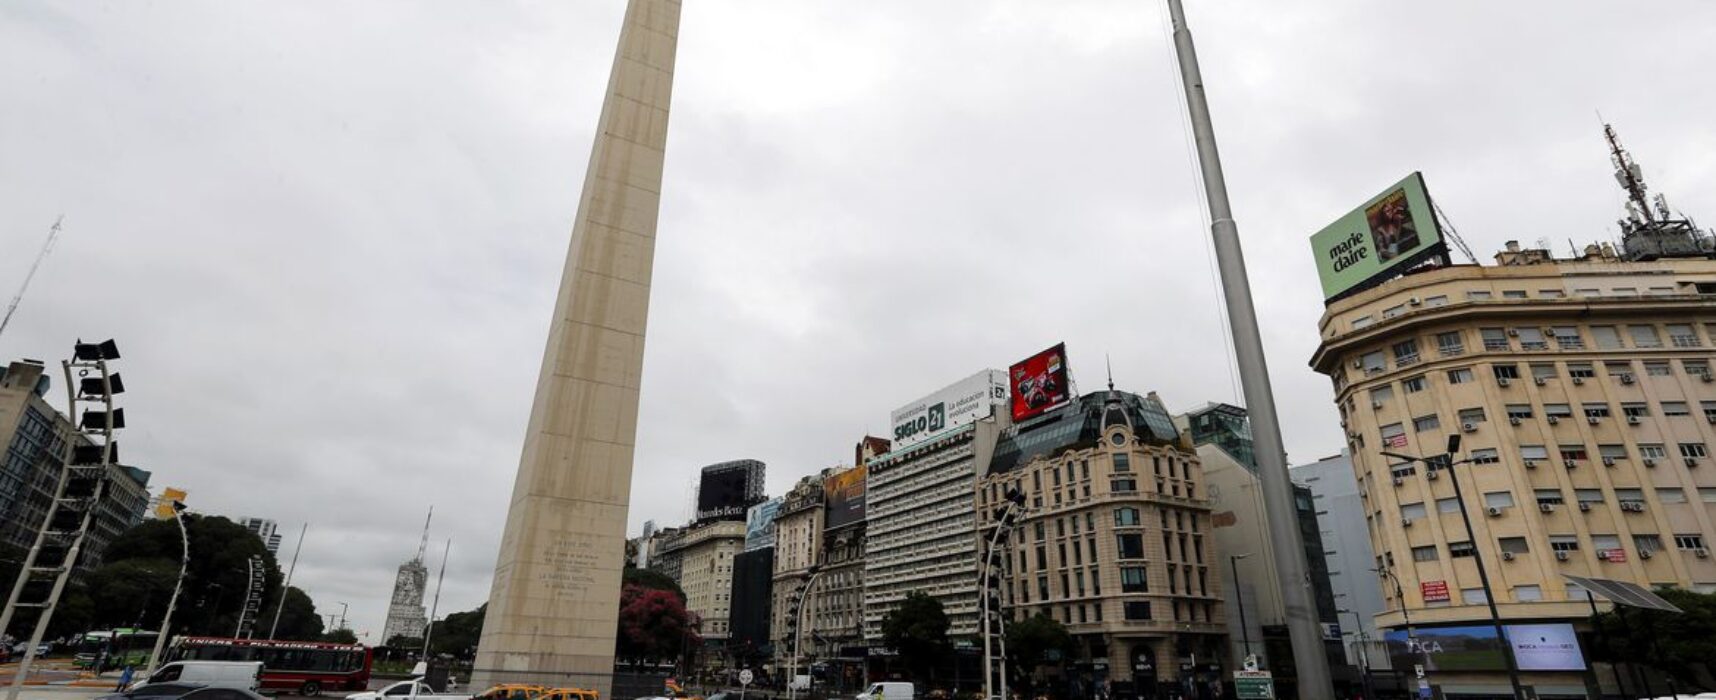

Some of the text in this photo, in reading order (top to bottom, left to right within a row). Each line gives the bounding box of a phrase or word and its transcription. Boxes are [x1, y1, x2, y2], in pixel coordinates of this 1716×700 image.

[1330, 232, 1363, 260] marie
[1334, 246, 1367, 273] claire
[949, 402, 956, 410] La
[949, 401, 979, 419] evoluciona
[894, 415, 927, 442] SIGLO
